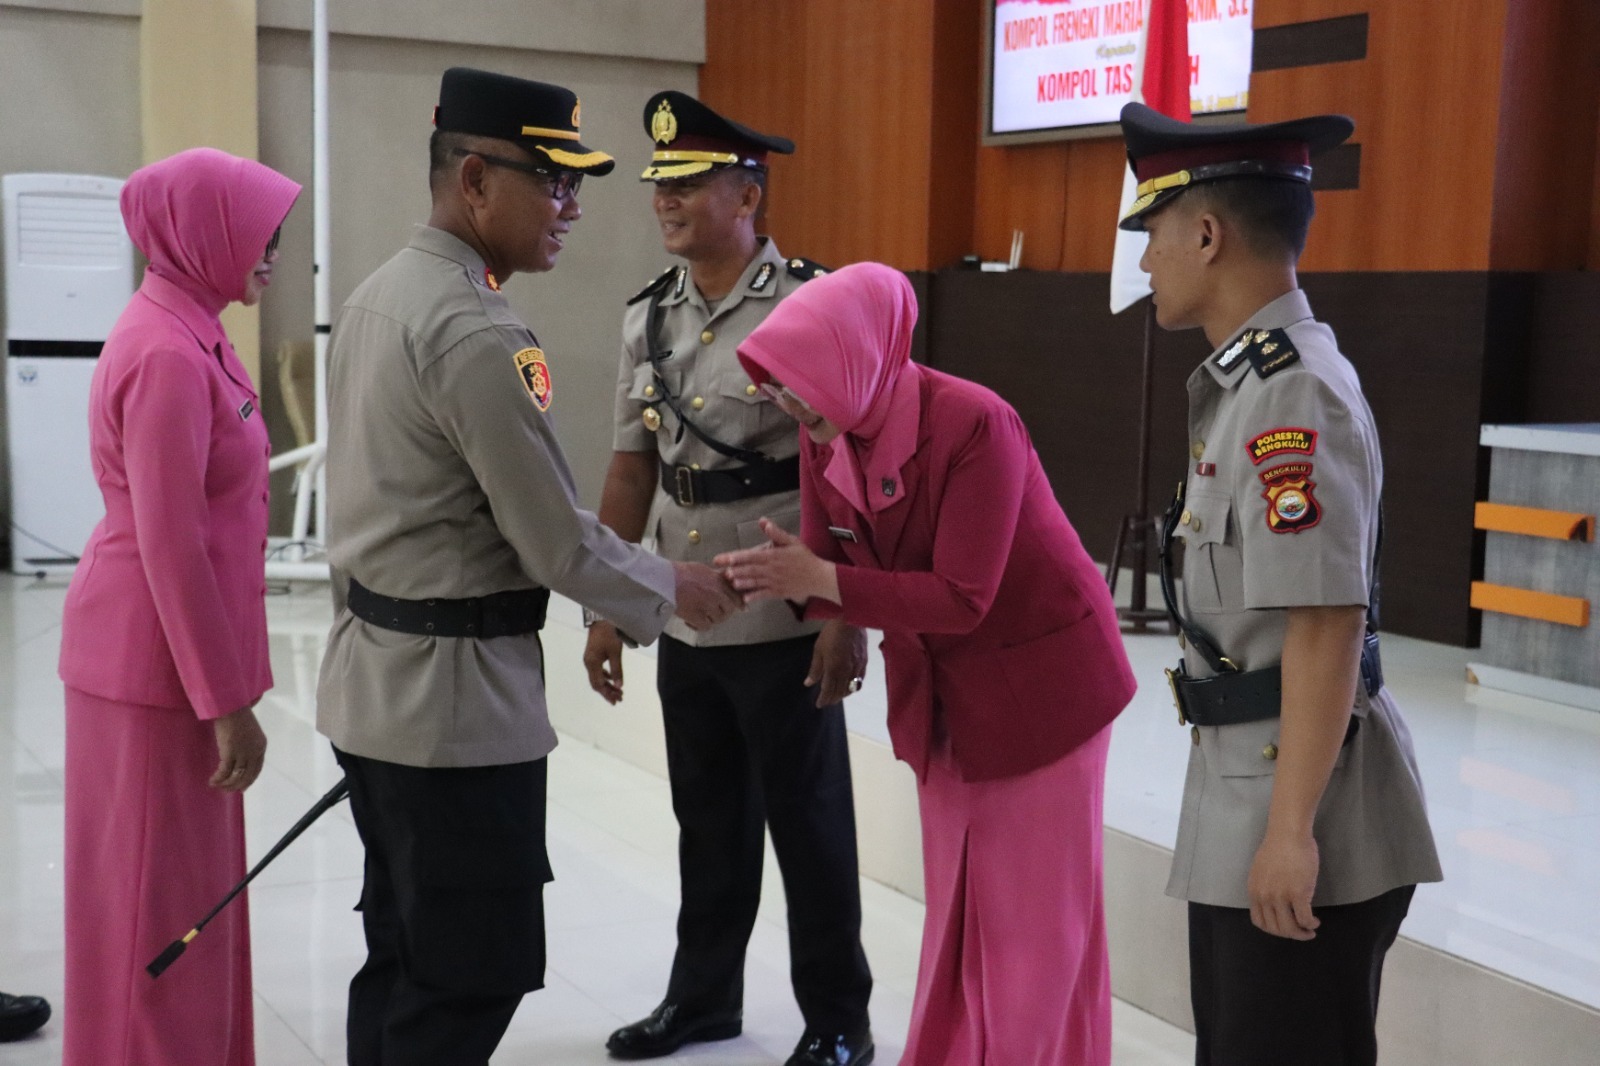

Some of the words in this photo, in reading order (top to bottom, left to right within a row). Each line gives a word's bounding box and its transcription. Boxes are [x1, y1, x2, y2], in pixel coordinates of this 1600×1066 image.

[1003, 15, 1048, 52] KOMPOL
[1053, 6, 1099, 45] FRENGKI
[1037, 68, 1098, 103] KOMPOL
[1257, 432, 1303, 447] POLRESTA
[1255, 441, 1308, 456] BENGKULU
[1264, 466, 1306, 480] BENGKULU
